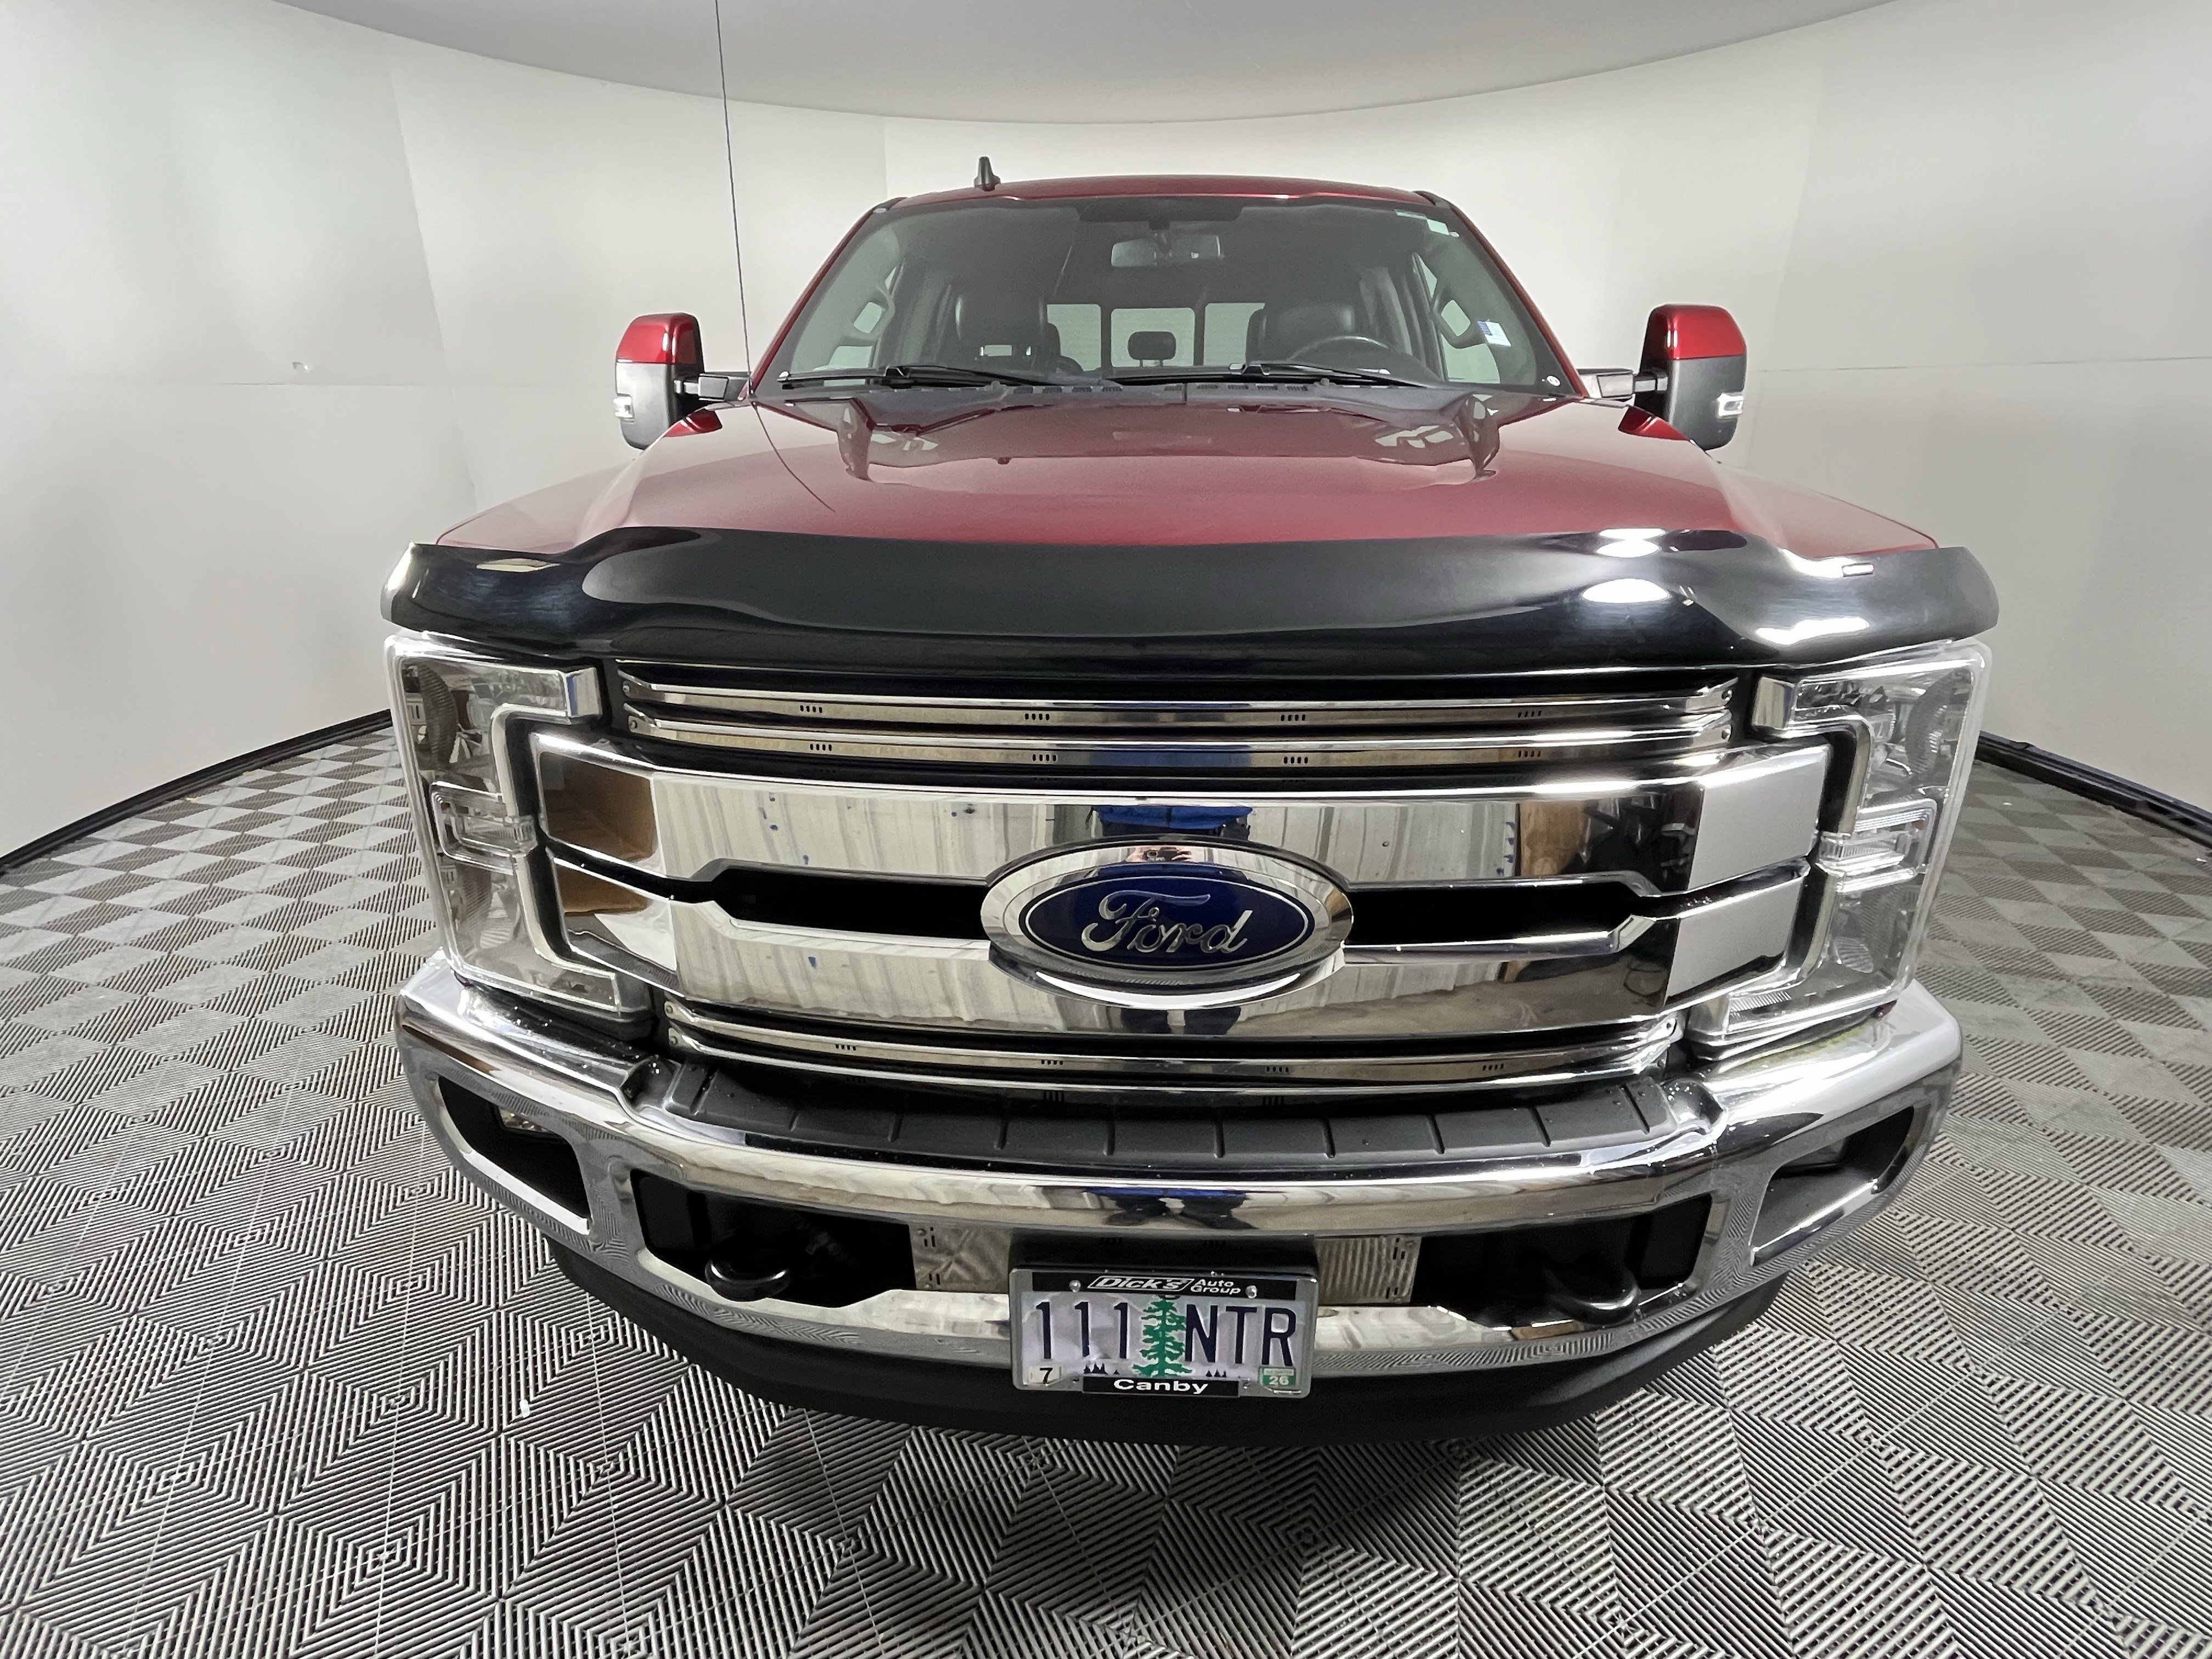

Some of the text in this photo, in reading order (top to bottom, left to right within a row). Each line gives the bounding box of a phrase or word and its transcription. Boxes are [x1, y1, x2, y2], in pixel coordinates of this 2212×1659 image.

[1081, 890, 1252, 953] Ford
[1190, 1285, 1242, 1295] Group
[1195, 1279, 1234, 1287] Auto
[1036, 1301, 1296, 1367] 111 NTR
[1040, 1367, 1053, 1384] 7
[1114, 1379, 1208, 1395] Canby
